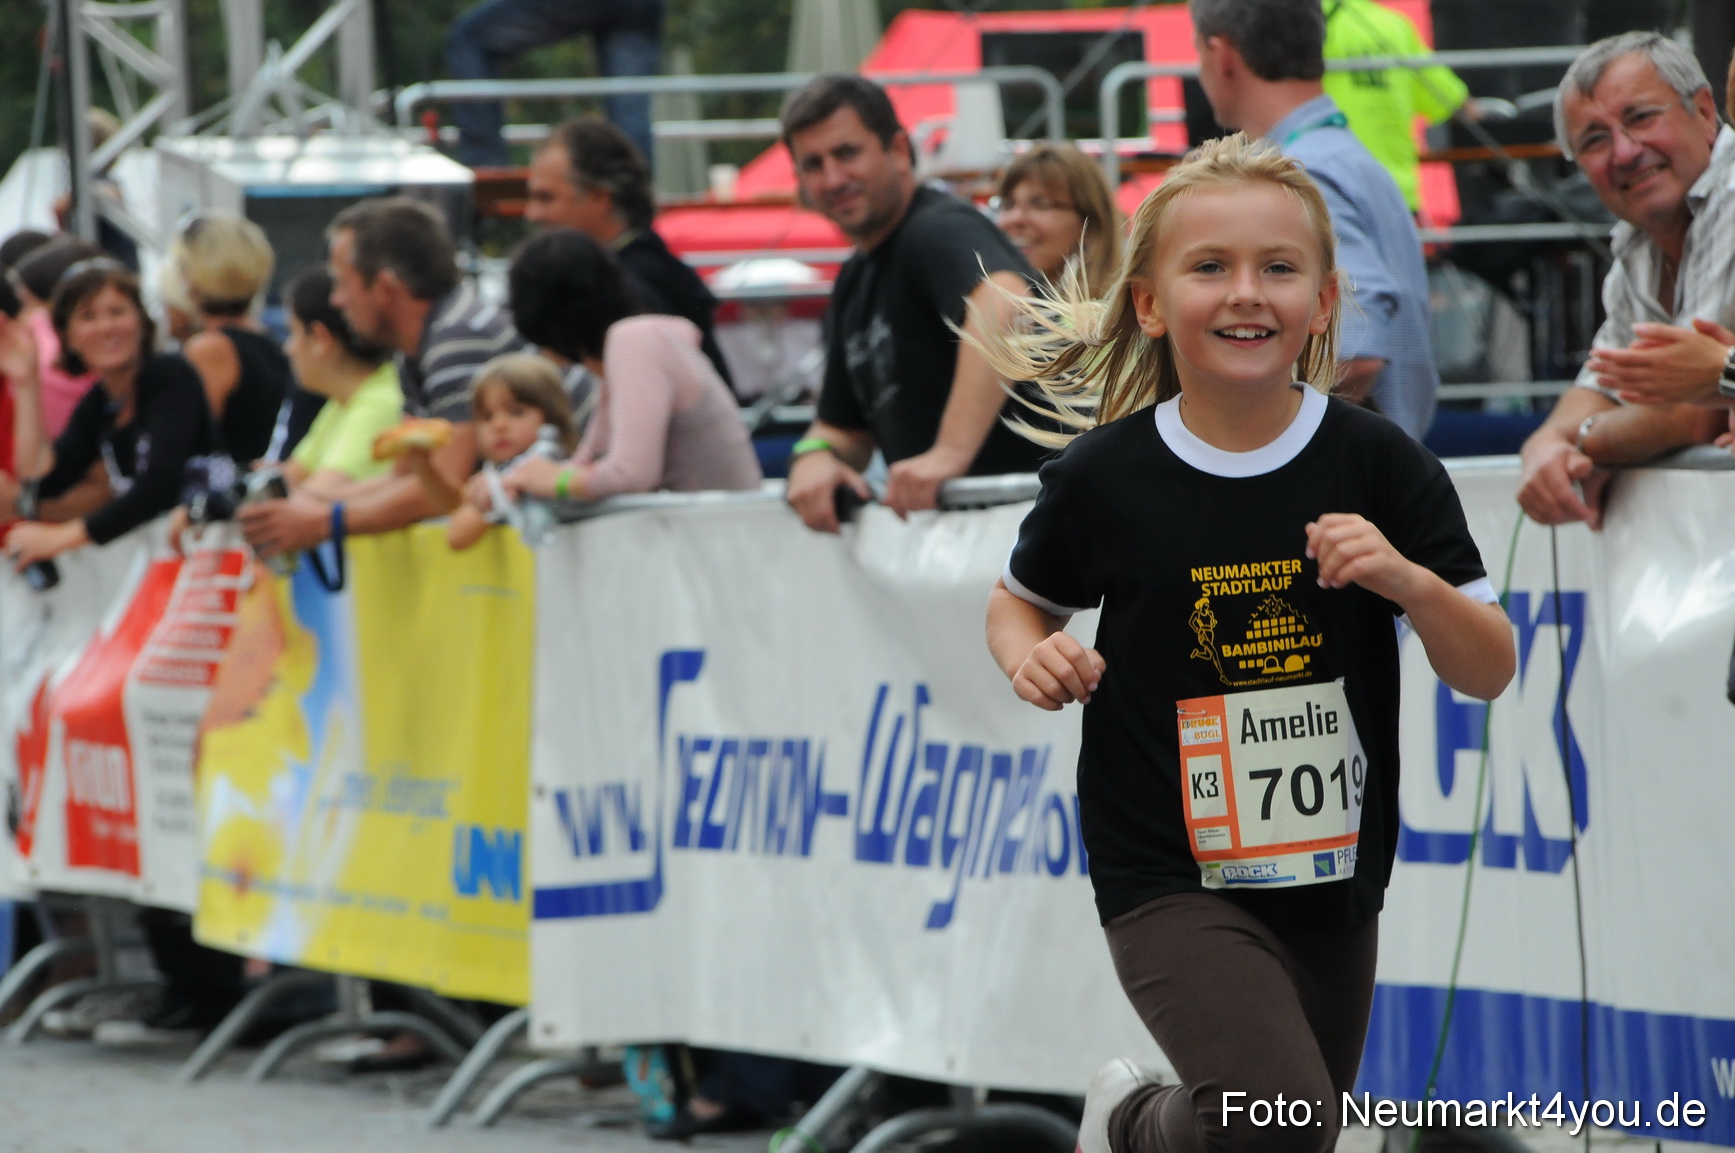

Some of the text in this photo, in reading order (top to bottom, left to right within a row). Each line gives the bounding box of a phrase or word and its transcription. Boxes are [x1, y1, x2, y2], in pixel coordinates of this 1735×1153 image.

[1190, 559, 1302, 582] NEUMARKTER
[1201, 576, 1292, 597] STADTLAUF
[1221, 633, 1323, 657] BAMBINILAU
[1232, 671, 1313, 687] www.stadtlauf-neumarkt.de
[1240, 701, 1339, 744] Amelie
[1191, 771, 1219, 800] K3
[1249, 754, 1364, 821] 7019
